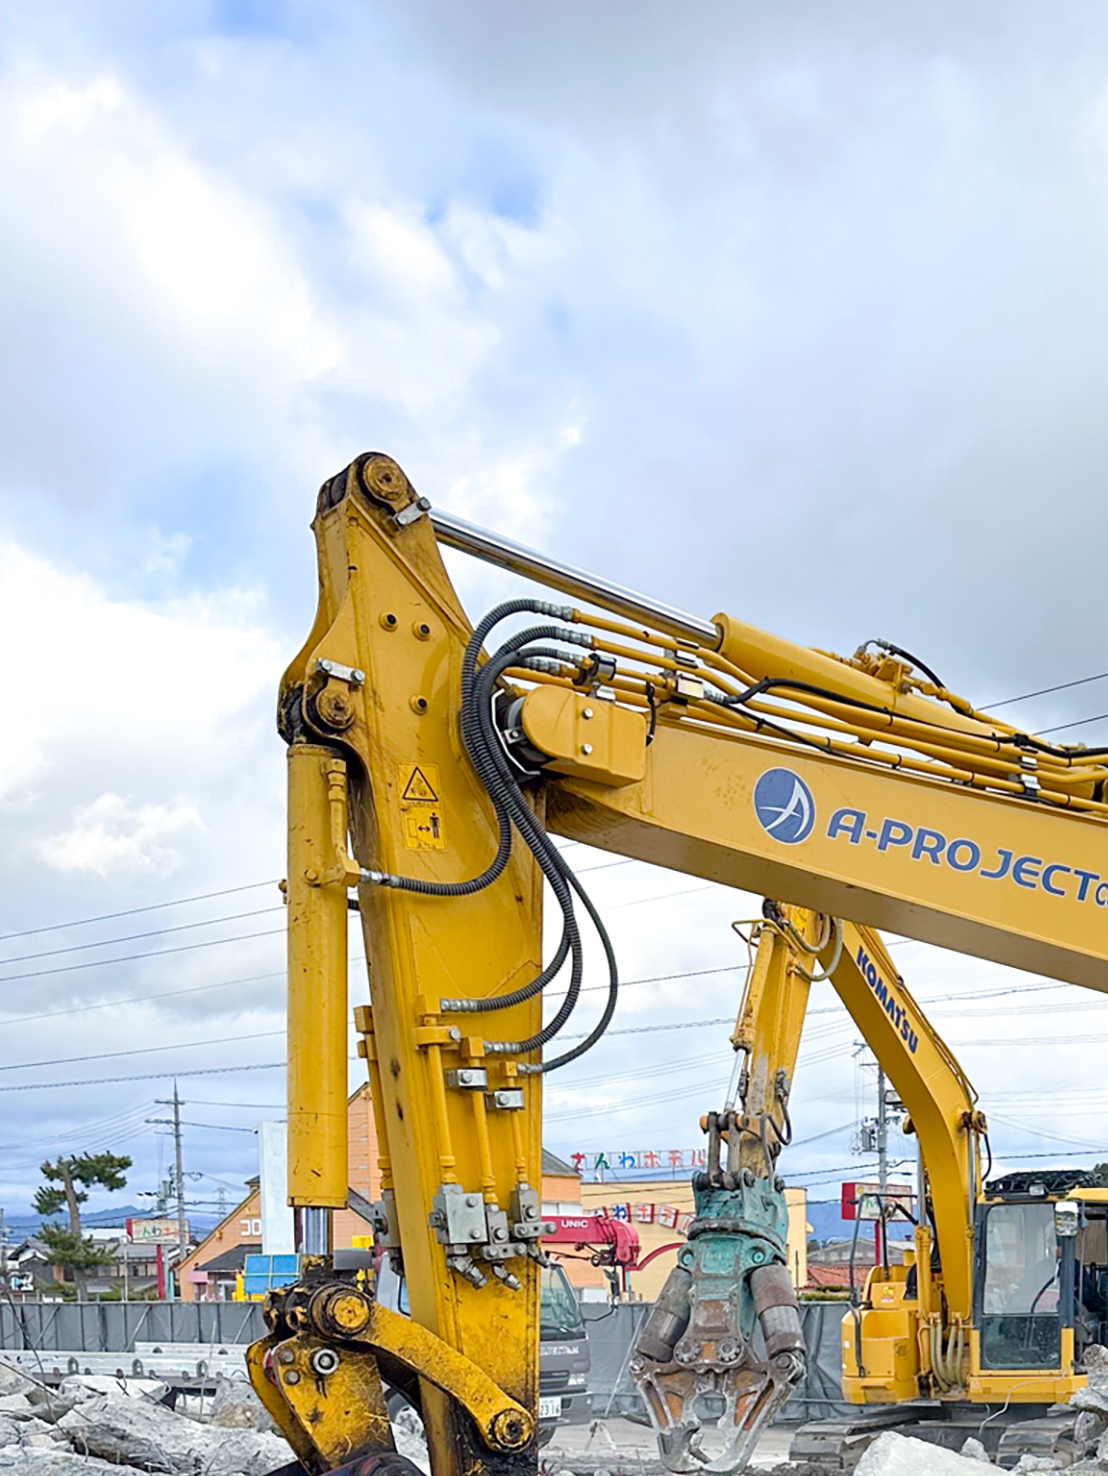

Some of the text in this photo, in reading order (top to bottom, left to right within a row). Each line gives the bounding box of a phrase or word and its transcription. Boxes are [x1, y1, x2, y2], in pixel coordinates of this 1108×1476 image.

[826, 807, 1100, 902] A-PROJECT
[856, 945, 918, 1054] KOMATSU
[561, 1219, 589, 1228] UNIC
